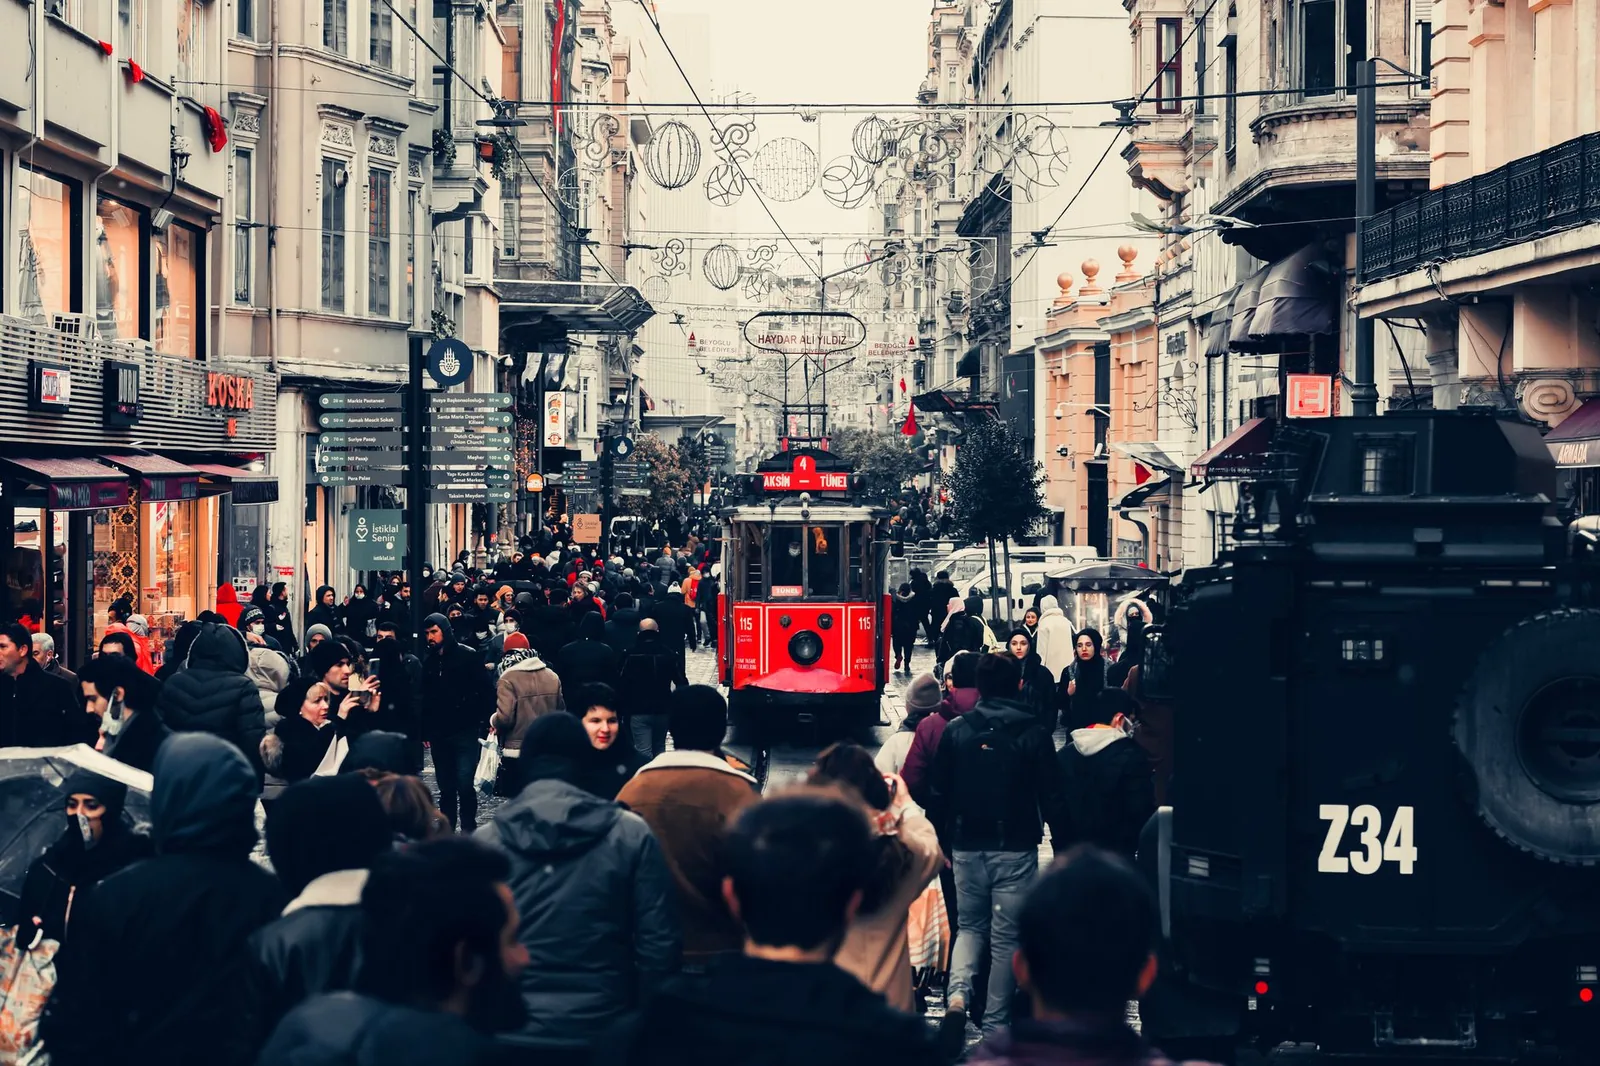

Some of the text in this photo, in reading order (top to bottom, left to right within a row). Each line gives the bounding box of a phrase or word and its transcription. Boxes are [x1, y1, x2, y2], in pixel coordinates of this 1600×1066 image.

[758, 334, 847, 345] HAYDAR ALİ YILDIZ
[208, 371, 254, 409] KOSKA
[1557, 443, 1588, 464] ARMADA
[800, 457, 807, 471] 4
[763, 474, 790, 487] AKSİM
[820, 474, 848, 488] TÜNEL
[372, 522, 399, 533] İstiklal
[372, 533, 396, 542] Senin
[740, 616, 753, 630] 115
[858, 616, 871, 630] 115
[1317, 804, 1418, 875] Z34
